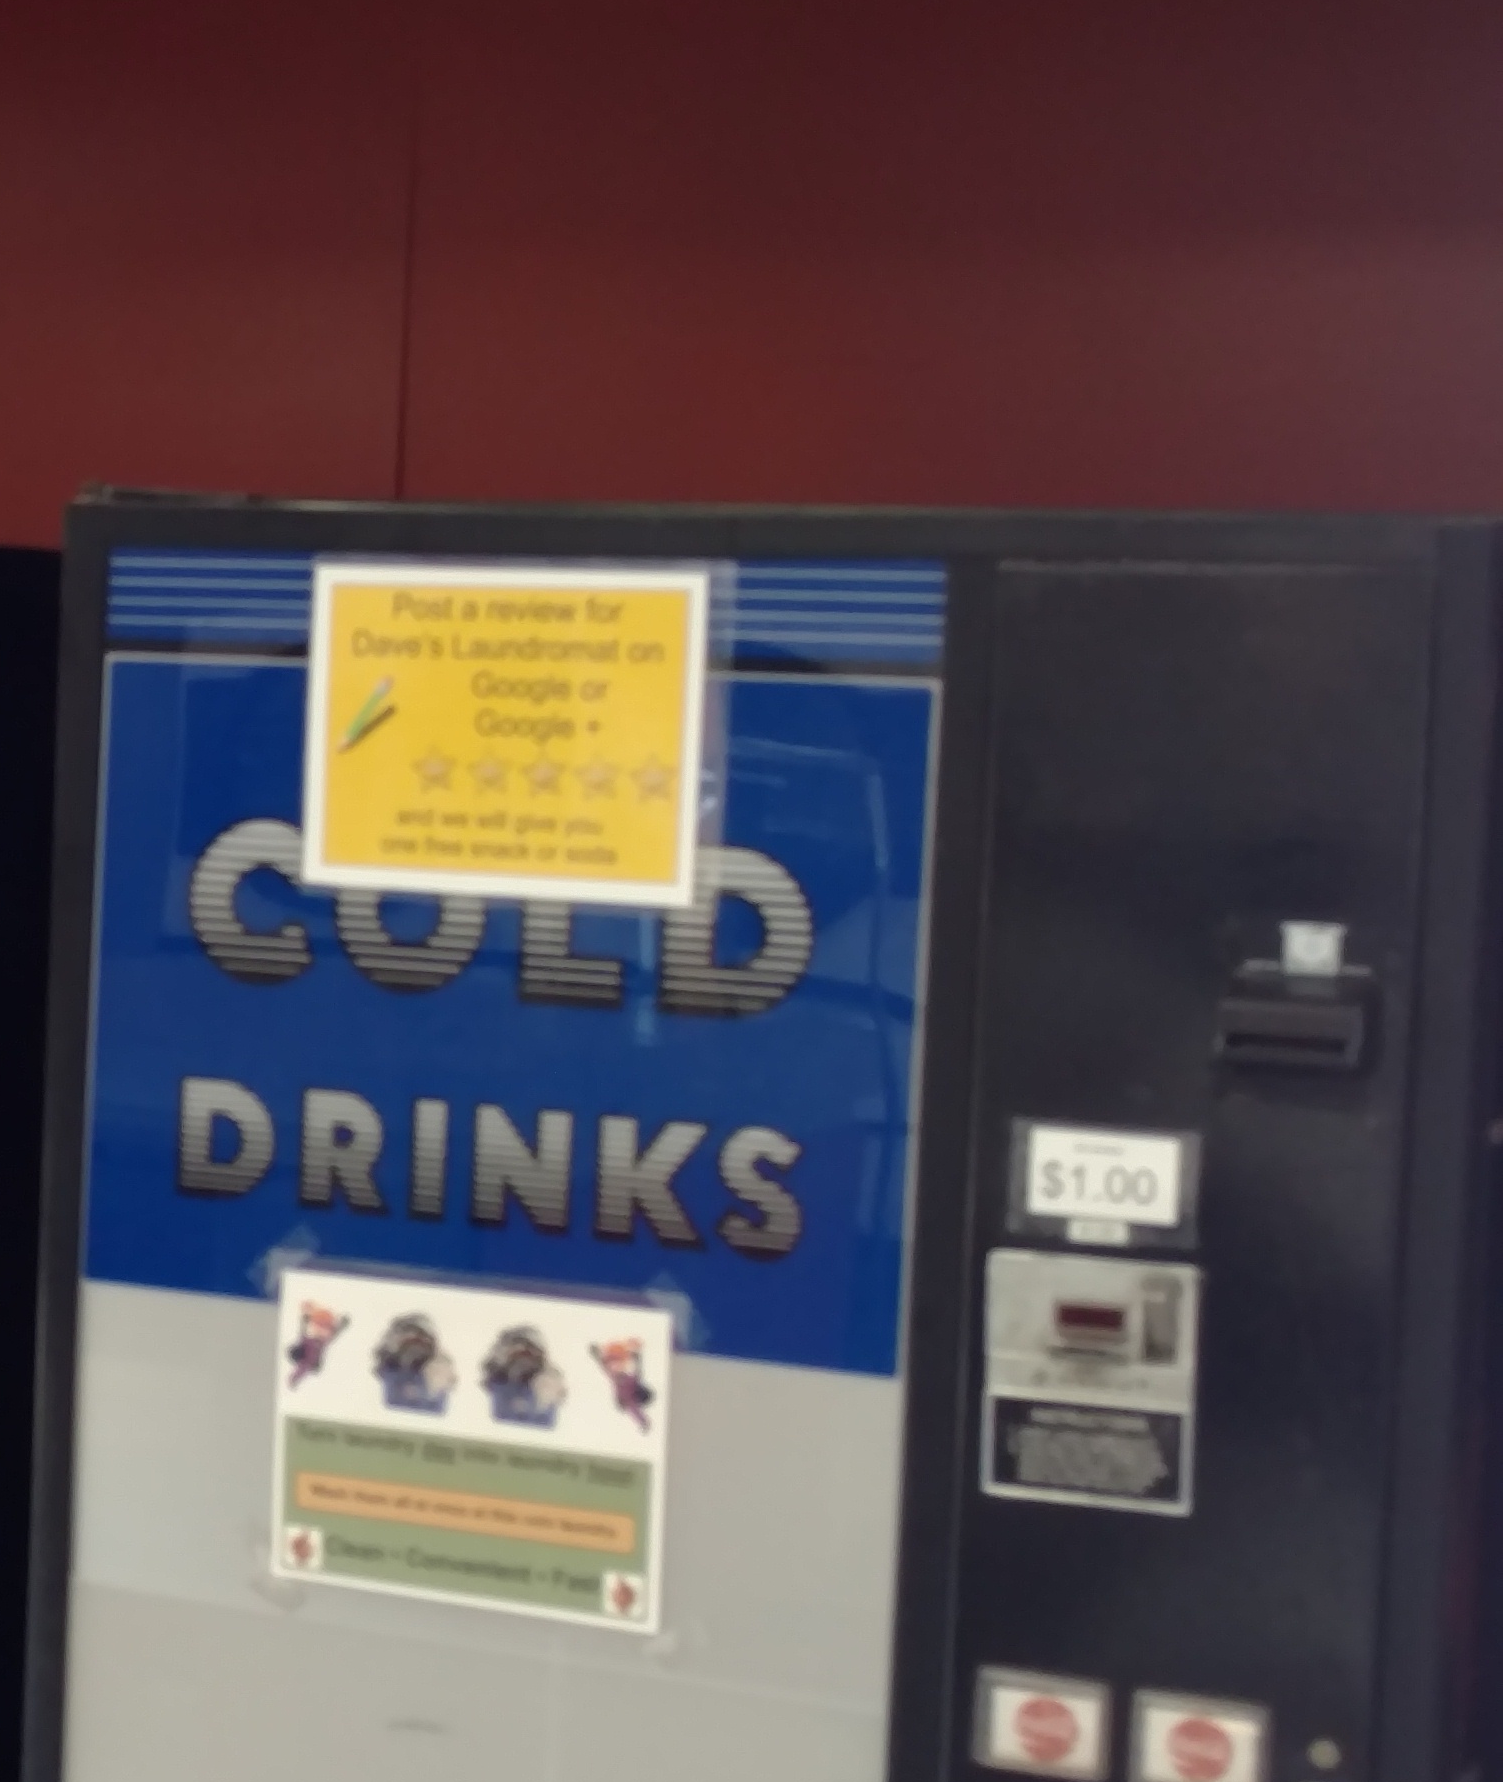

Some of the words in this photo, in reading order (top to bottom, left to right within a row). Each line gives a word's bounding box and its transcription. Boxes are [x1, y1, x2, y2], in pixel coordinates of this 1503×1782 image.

[392, 591, 453, 621] Post
[461, 599, 479, 621] a
[485, 599, 576, 623] review
[585, 597, 624, 624] for
[350, 627, 444, 660] Dave's
[452, 632, 619, 662] Laundromat
[627, 641, 666, 663] on
[471, 669, 571, 706] Google
[579, 679, 610, 701] or
[474, 708, 576, 744] Google
[396, 809, 435, 828] and
[441, 813, 469, 828] we
[476, 810, 507, 829] will
[515, 816, 558, 836] give
[564, 818, 605, 837] you
[380, 838, 417, 854] one
[425, 837, 464, 856] free
[470, 840, 530, 861] snack
[537, 846, 557, 861] or
[189, 817, 815, 1020] COLD
[177, 1075, 804, 1261] DRINKS
[1038, 1157, 1161, 1207] $1.00
[325, 1533, 386, 1564] Clean
[404, 1544, 532, 1585] Convenient
